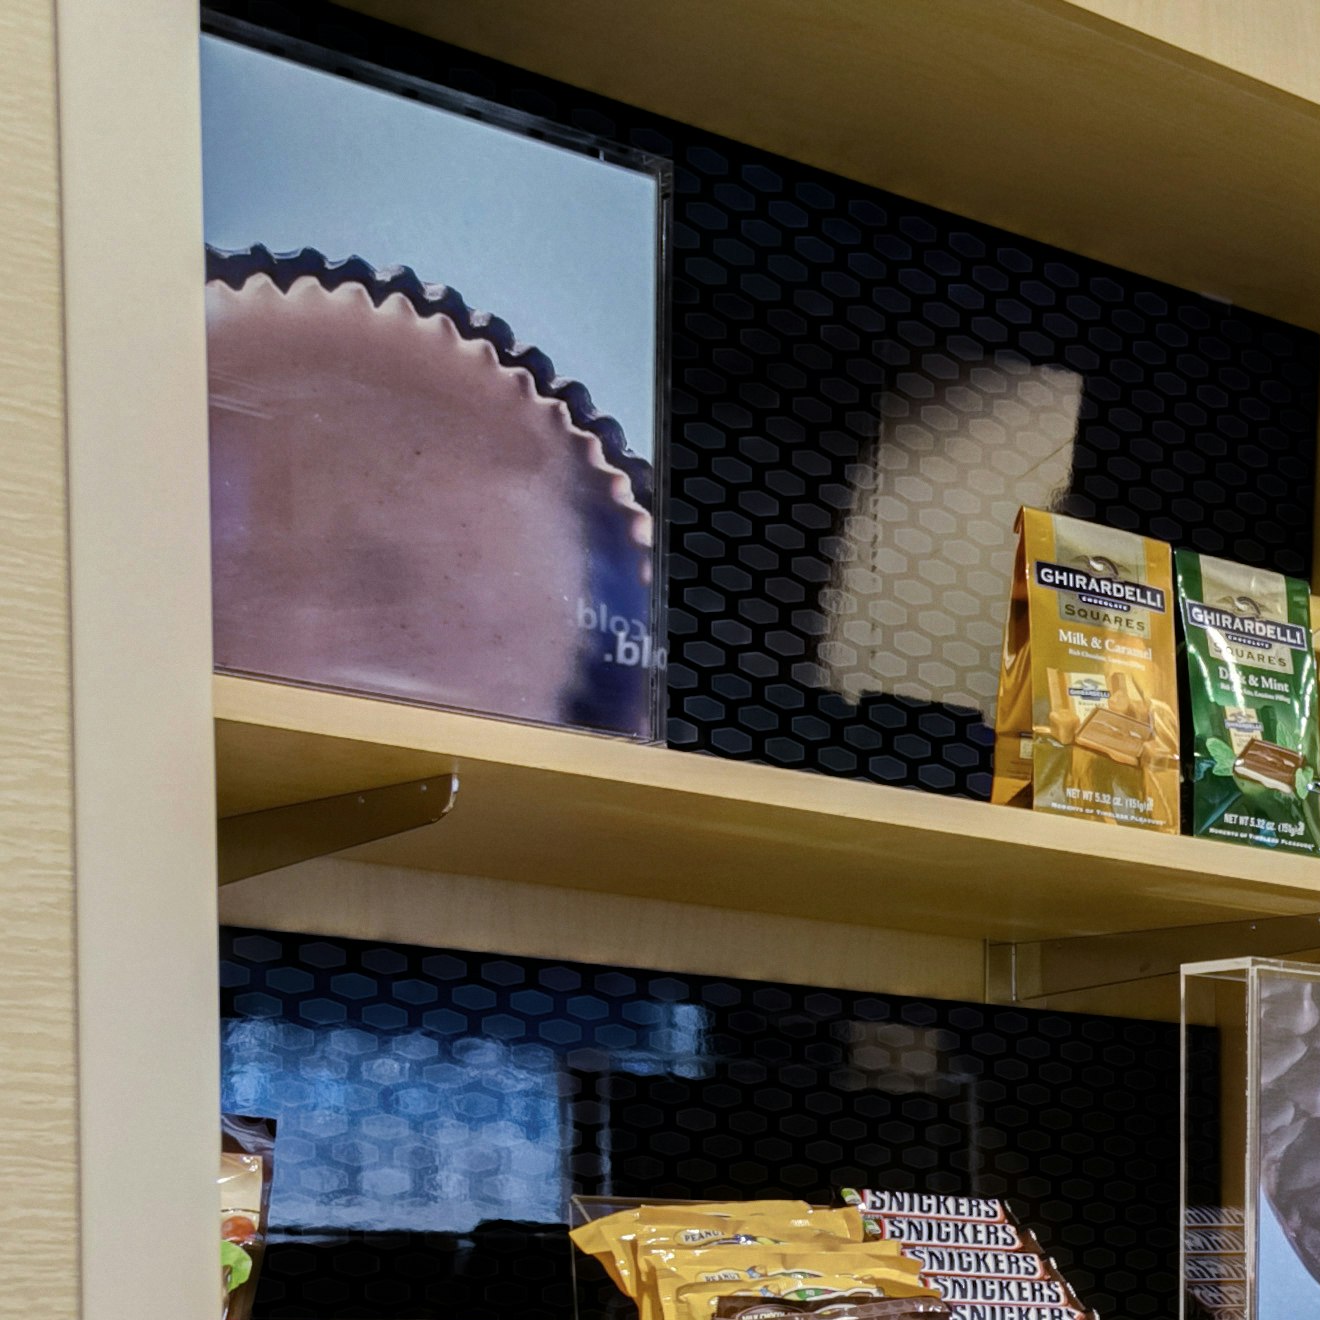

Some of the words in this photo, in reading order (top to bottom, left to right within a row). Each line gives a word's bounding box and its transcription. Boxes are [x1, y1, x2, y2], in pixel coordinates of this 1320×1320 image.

[1040, 568, 1163, 608] GHIRARDELLI
[1081, 596, 1129, 610] CHOCOLATE
[1064, 603, 1146, 632] SQUARES
[1191, 607, 1304, 646] GHIRARDELLI
[1057, 628, 1088, 648] Milk
[1091, 638, 1102, 650] &
[1105, 639, 1153, 661] Caramel
[1213, 642, 1287, 667] SQUARES
[1228, 634, 1271, 650] CHOCOLATE
[1248, 674, 1260, 687] &
[1261, 675, 1290, 693] Mint
[1066, 787, 1081, 799] NET
[1082, 789, 1092, 802] WT
[1223, 813, 1239, 825] NET
[870, 1190, 999, 1219] SNICKERS
[888, 1219, 1018, 1247] SNICKERS
[911, 1249, 1038, 1277] SNICKERS
[934, 1277, 1062, 1304] SNICKERS
